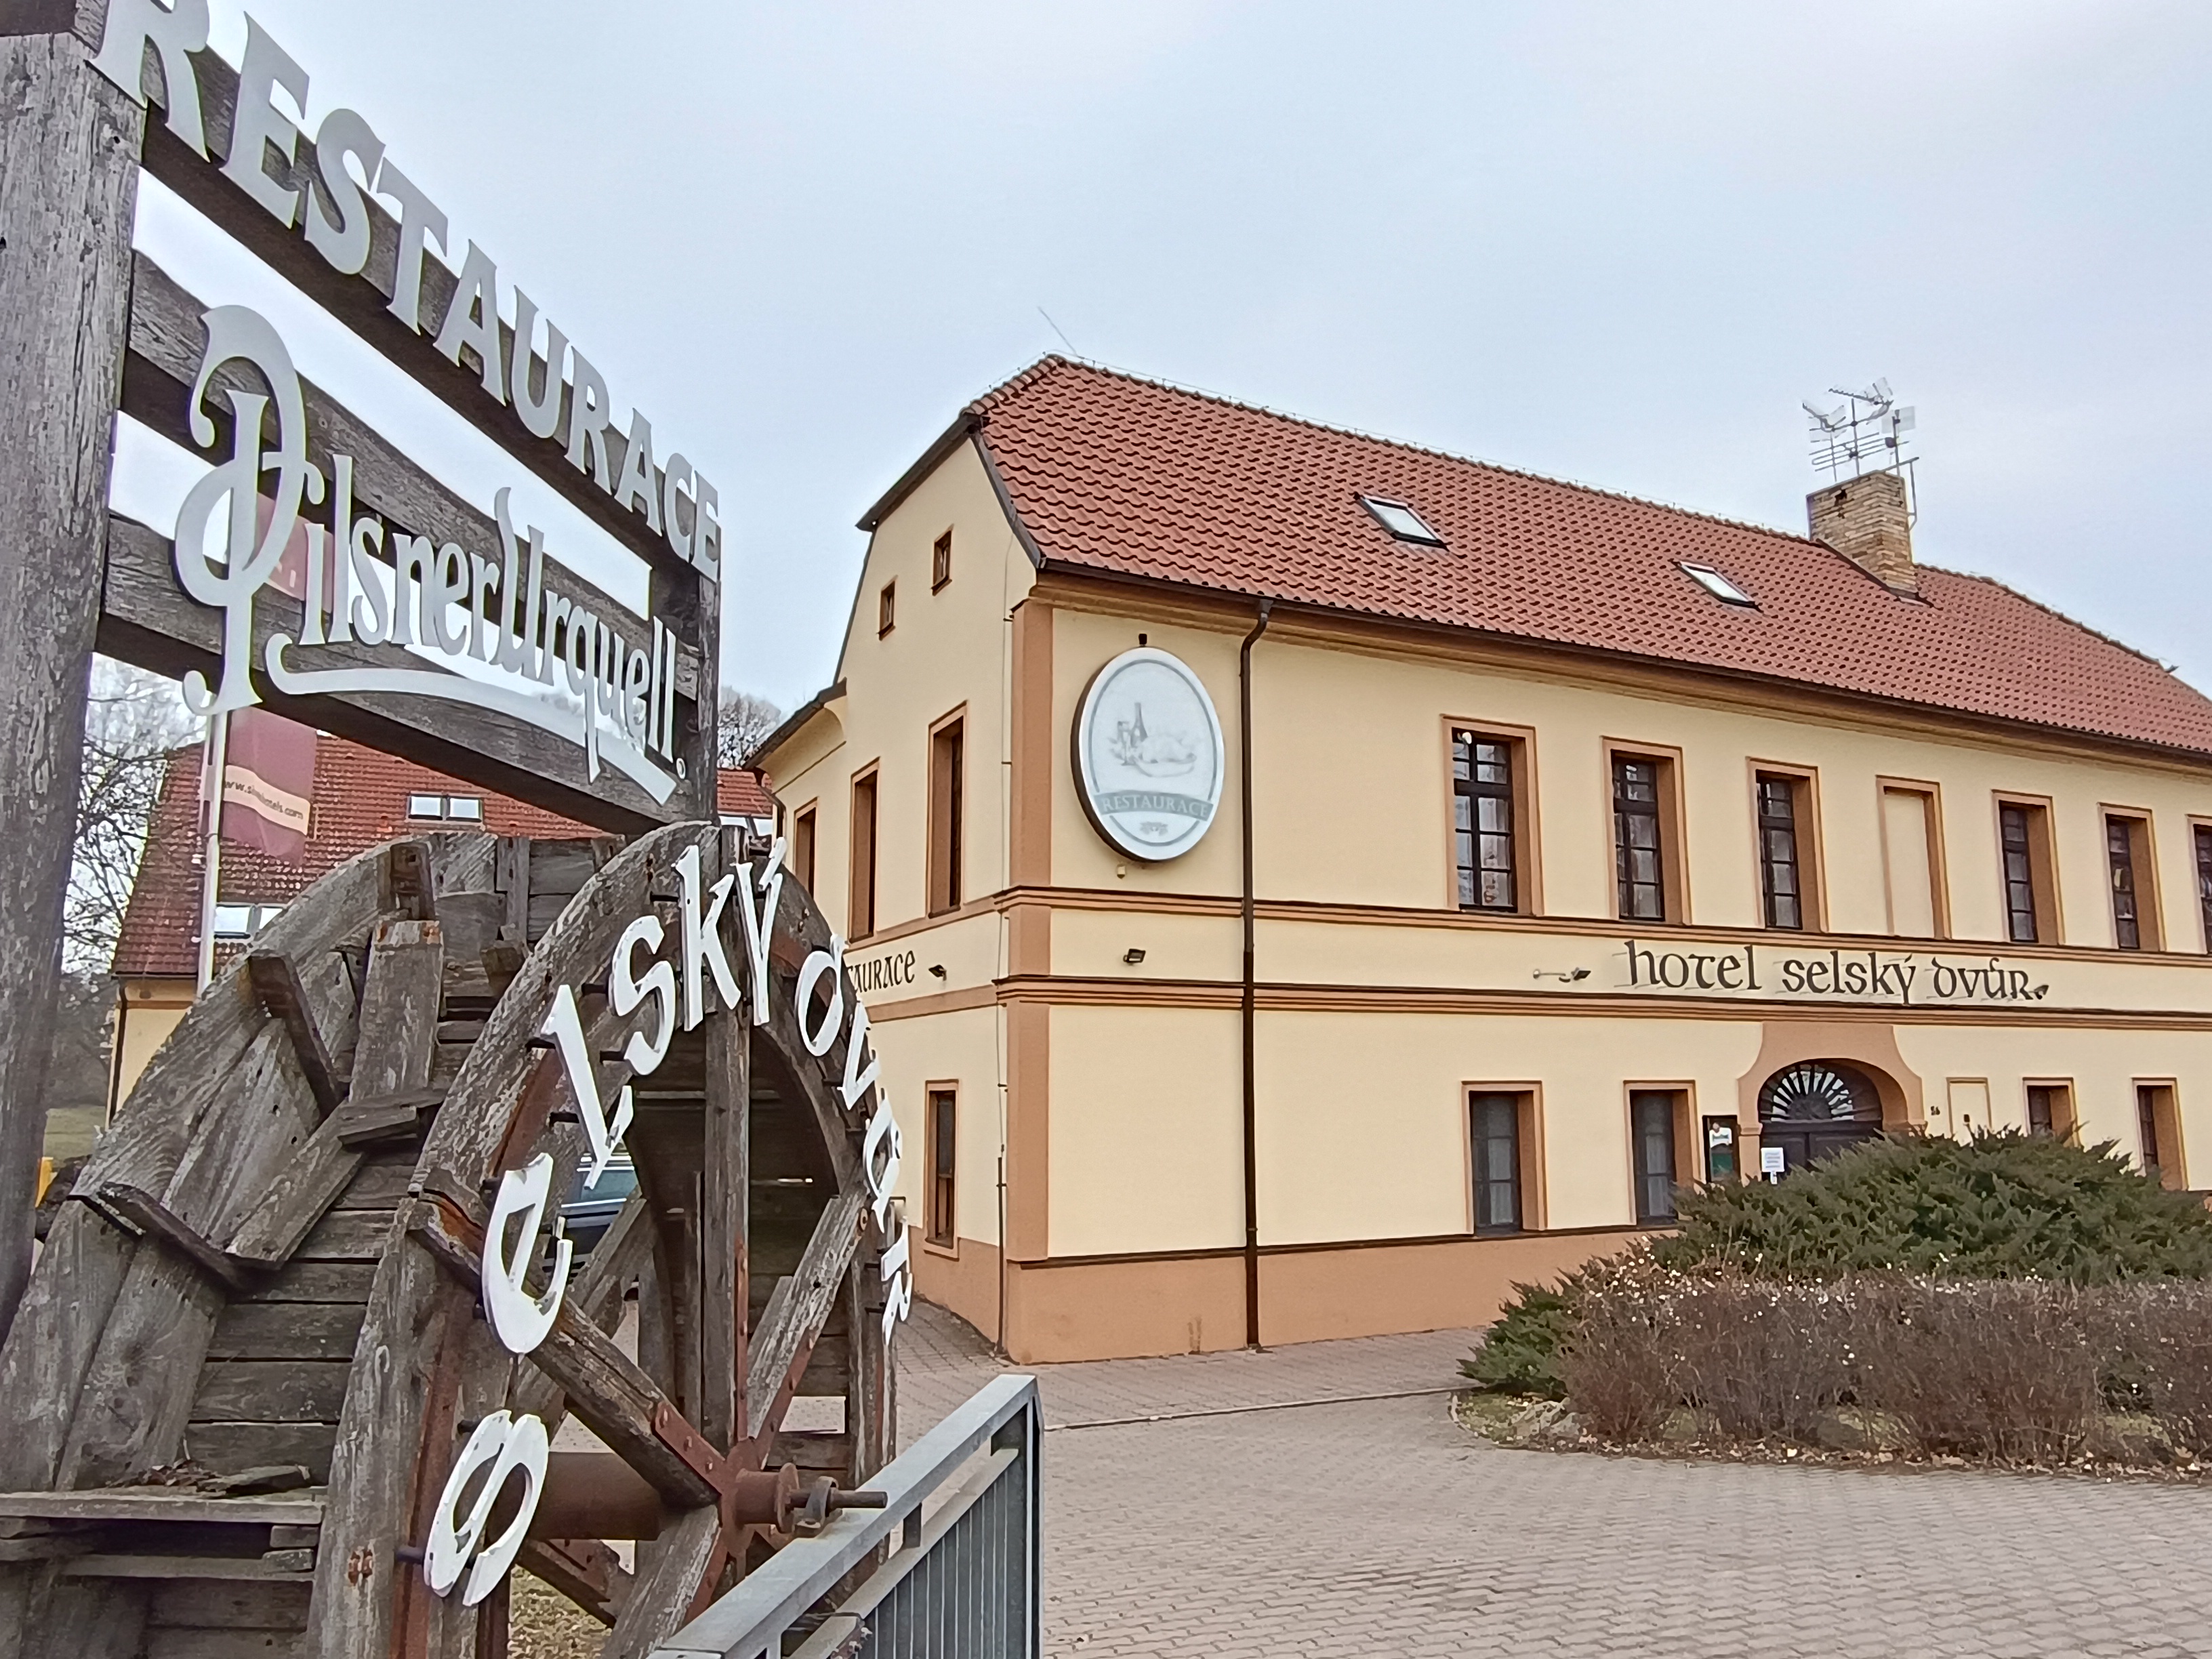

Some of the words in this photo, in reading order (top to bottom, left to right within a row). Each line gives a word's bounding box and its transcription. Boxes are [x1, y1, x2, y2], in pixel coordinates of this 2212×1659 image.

[85, 0, 718, 584] RESTAURACE
[175, 304, 500, 715] Pilsner
[493, 487, 676, 783] Urquell
[1101, 794, 1209, 818] RESTAURACE
[1624, 940, 1762, 991] hotel
[1782, 950, 1917, 1006] selský
